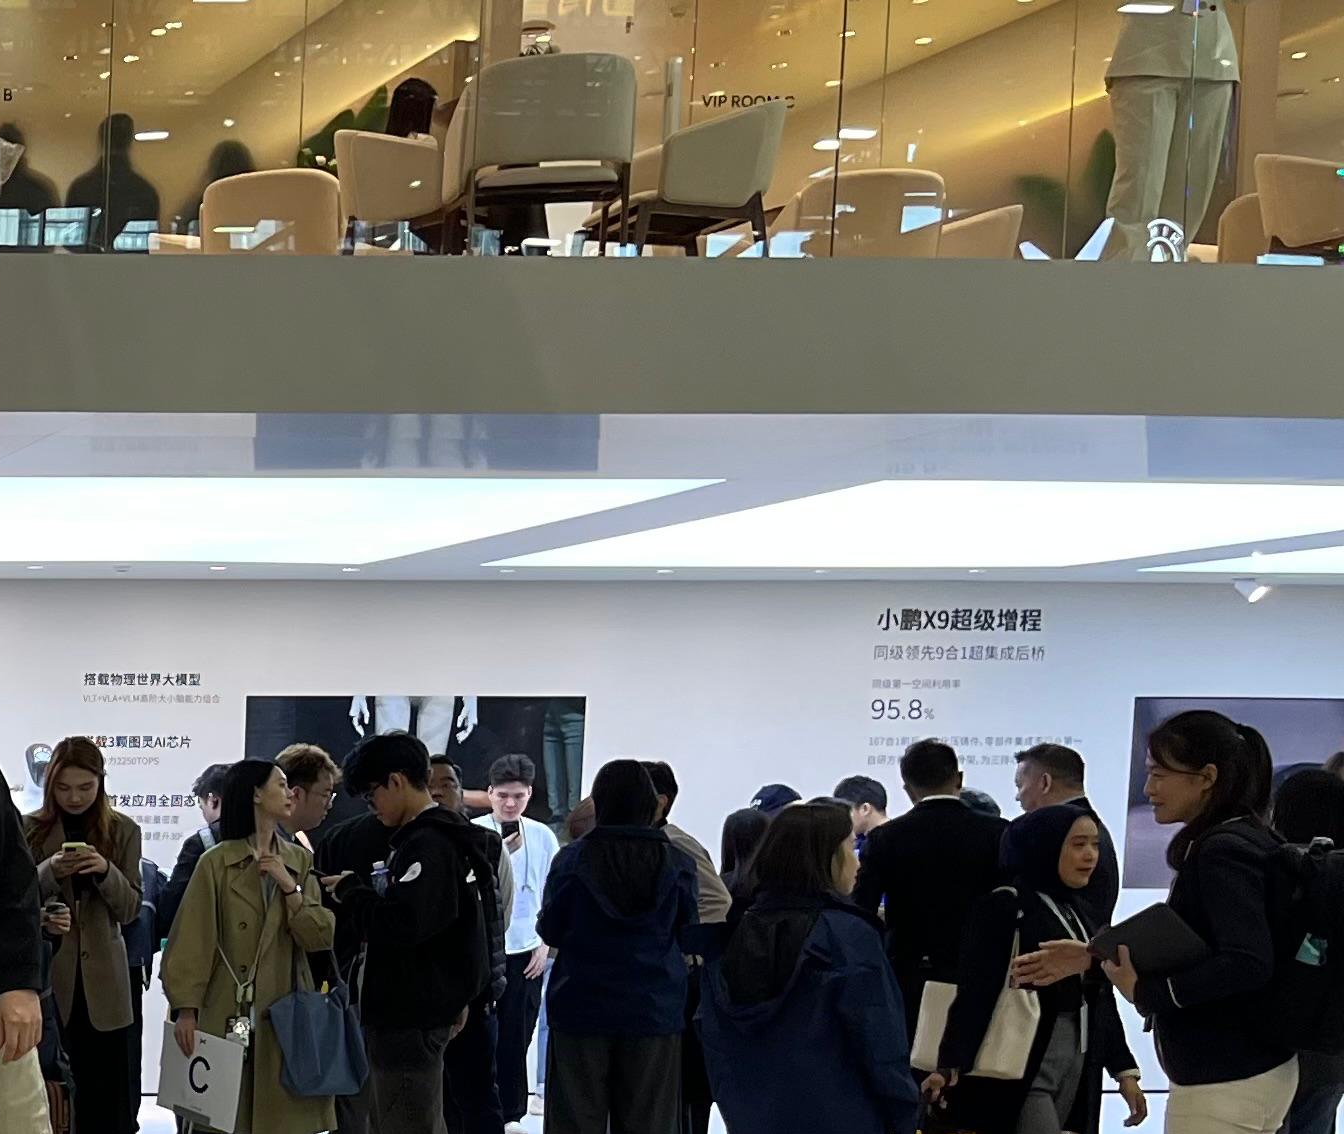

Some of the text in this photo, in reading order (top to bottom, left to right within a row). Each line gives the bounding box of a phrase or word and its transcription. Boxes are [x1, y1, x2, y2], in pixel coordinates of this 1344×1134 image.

[702, 95, 728, 108] VIP
[877, 608, 1042, 632] 小鹏X9超级增程
[873, 645, 1045, 662] 同级领先9合1超集成后桥
[84, 672, 201, 686] 搭载物理世界大模型
[871, 699, 935, 720] 95.8%
[188, 1055, 211, 1094] C
